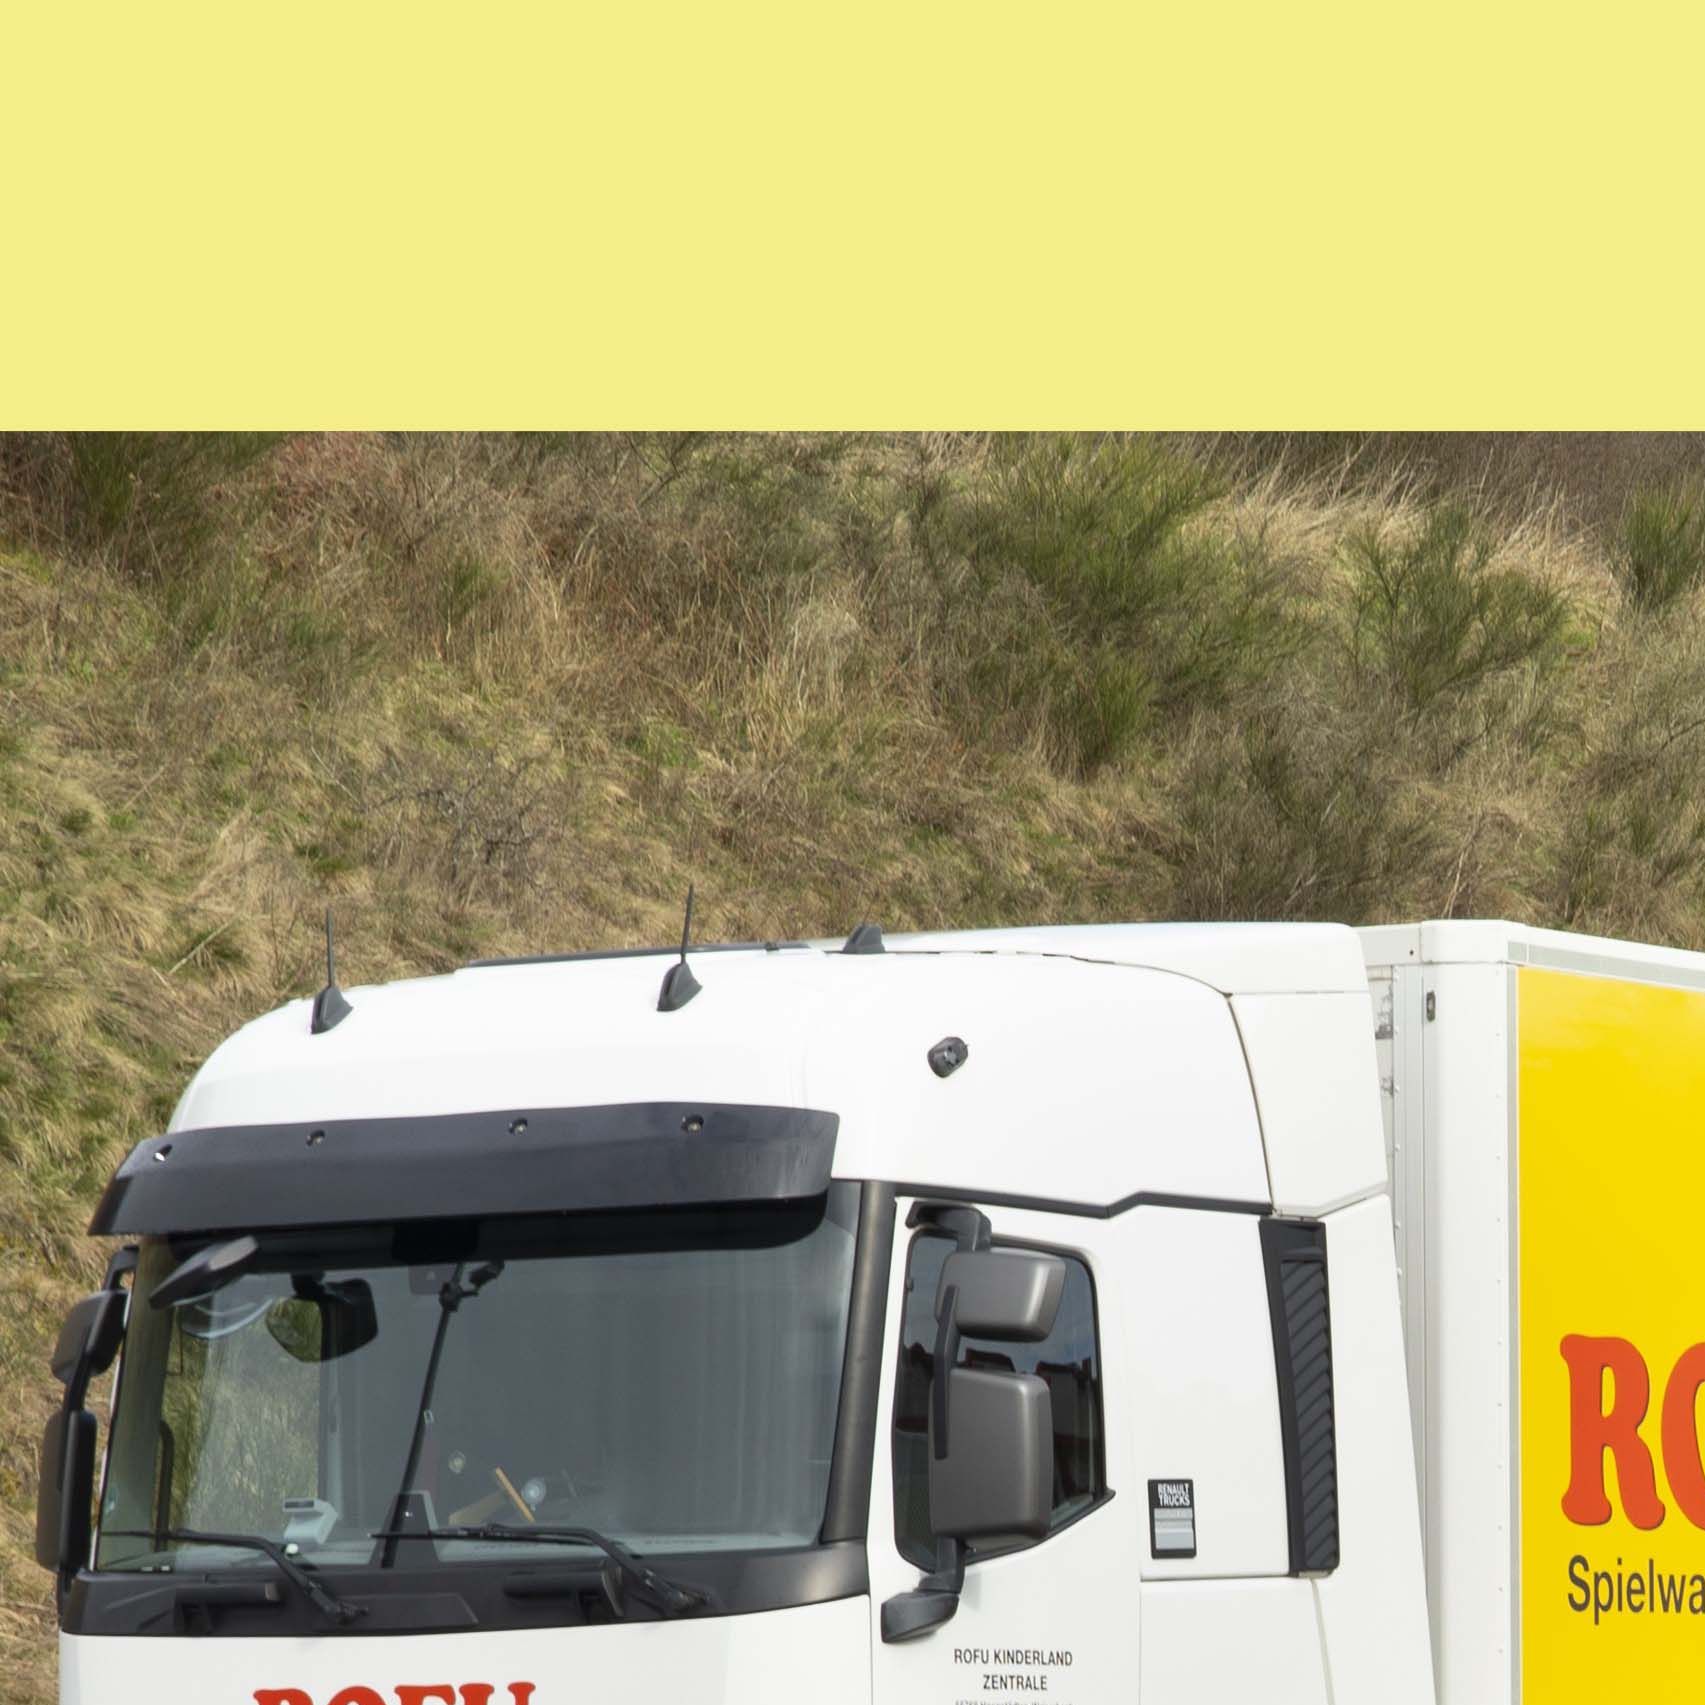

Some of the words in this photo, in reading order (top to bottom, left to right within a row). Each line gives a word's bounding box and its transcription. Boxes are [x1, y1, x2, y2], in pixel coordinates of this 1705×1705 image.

[1160, 1494, 1190, 1506] TRUCKS
[953, 1648, 989, 1665] ROFU
[993, 1649, 1073, 1667] KINDERLAND
[983, 1674, 1048, 1691] ZENTRALE
